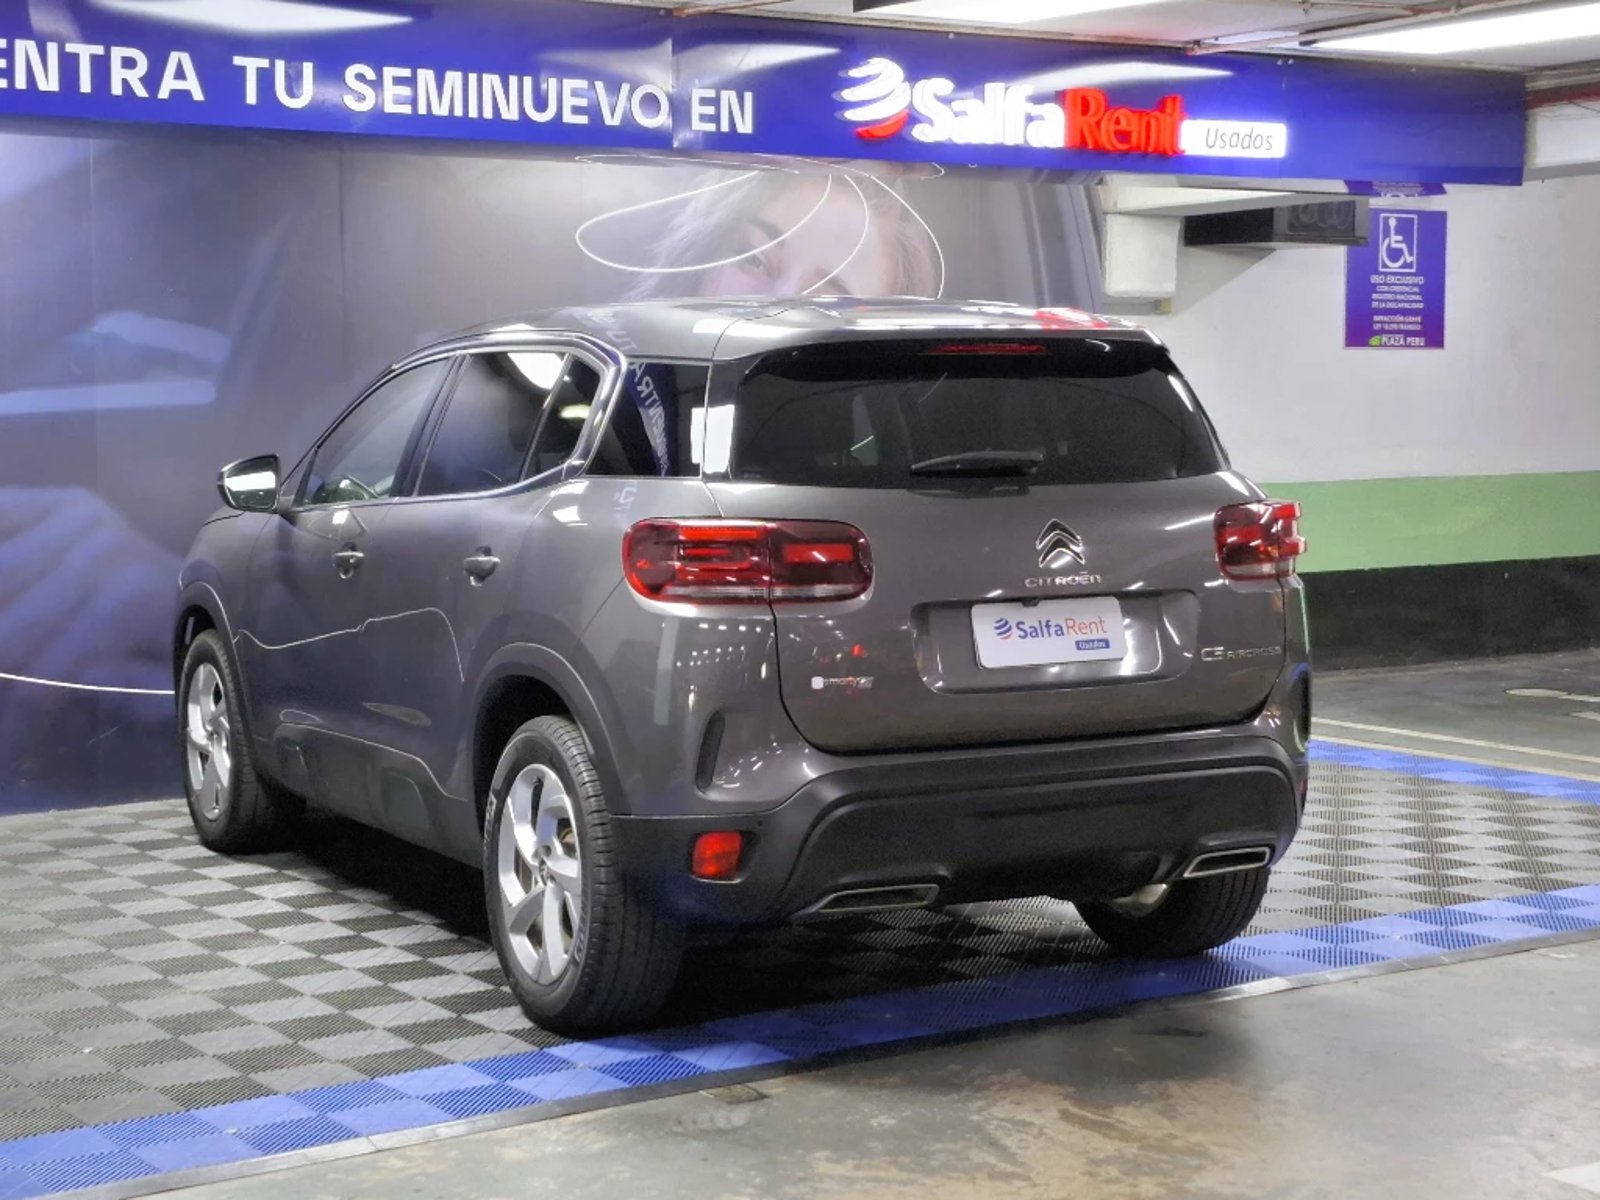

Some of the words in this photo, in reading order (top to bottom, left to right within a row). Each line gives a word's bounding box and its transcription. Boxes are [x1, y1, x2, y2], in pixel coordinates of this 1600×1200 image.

[0, 38, 205, 101] NTRA
[232, 55, 313, 109] TU
[343, 63, 670, 129] SEMINUEVO
[691, 87, 753, 134] EN
[1205, 127, 1273, 151] Usados
[1381, 335, 1405, 346] PLAZA
[1015, 616, 1108, 640] SalfaRent
[1079, 641, 1106, 650] Usados
